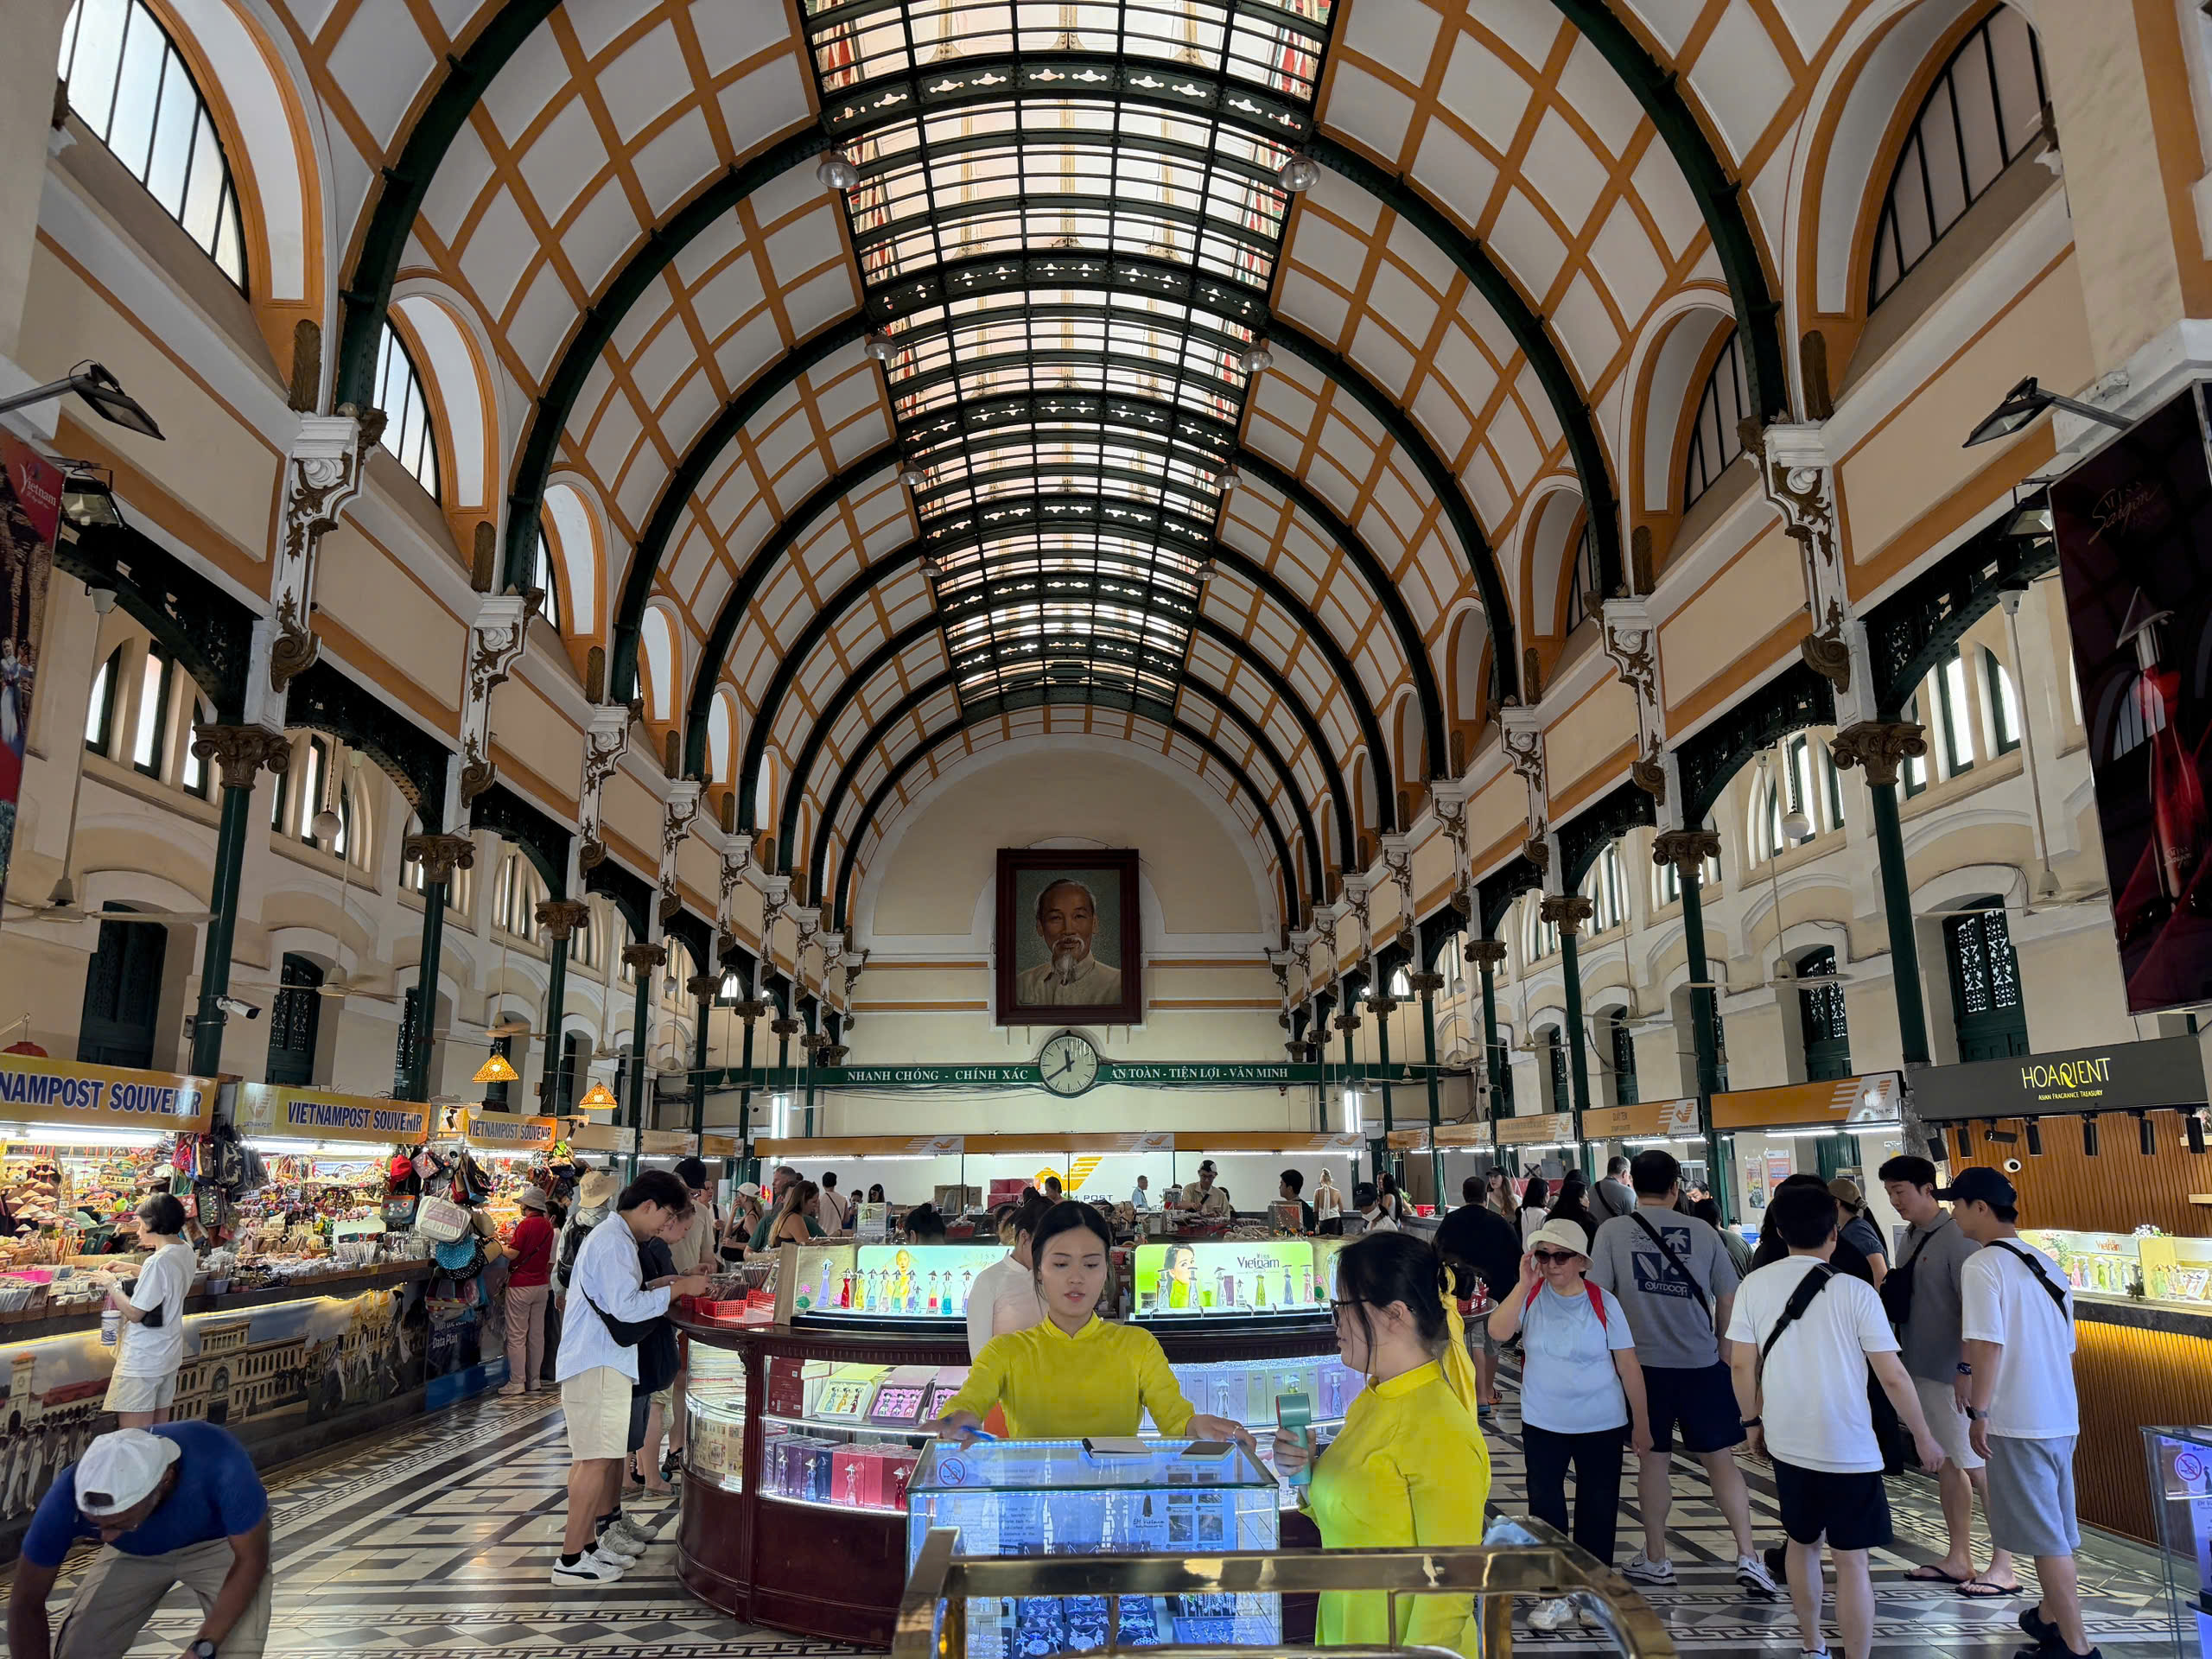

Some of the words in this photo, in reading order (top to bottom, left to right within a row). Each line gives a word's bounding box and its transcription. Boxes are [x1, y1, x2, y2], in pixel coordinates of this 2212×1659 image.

[847, 1071, 891, 1081] NHANH
[895, 1068, 939, 1081] CHÓNG
[955, 1067, 996, 1080] CHÍNH
[1002, 1067, 1028, 1080] XÁC
[1110, 1067, 1126, 1079] AN
[1128, 1065, 1160, 1078] TOÀN
[1169, 1065, 1198, 1080] TIỆN
[1200, 1066, 1220, 1080] LỢI
[1230, 1065, 1253, 1078] VĂN
[1256, 1068, 1287, 1077] MINH
[0, 1071, 104, 1109] NAMPOST
[110, 1083, 201, 1116] SOUVENR
[2052, 1091, 2079, 1100] FRAGRANCE
[2080, 1089, 2103, 1097] TREASURY
[289, 1101, 371, 1128] VIETNAMPOST
[373, 1109, 422, 1132] SOUVENIR
[468, 1120, 518, 1140] VIETNAMPOST
[520, 1124, 551, 1141] SOUVENIR
[1237, 1256, 1279, 1268] Vietnam
[432, 1336, 445, 1349] Data
[446, 1332, 458, 1345] Plan
